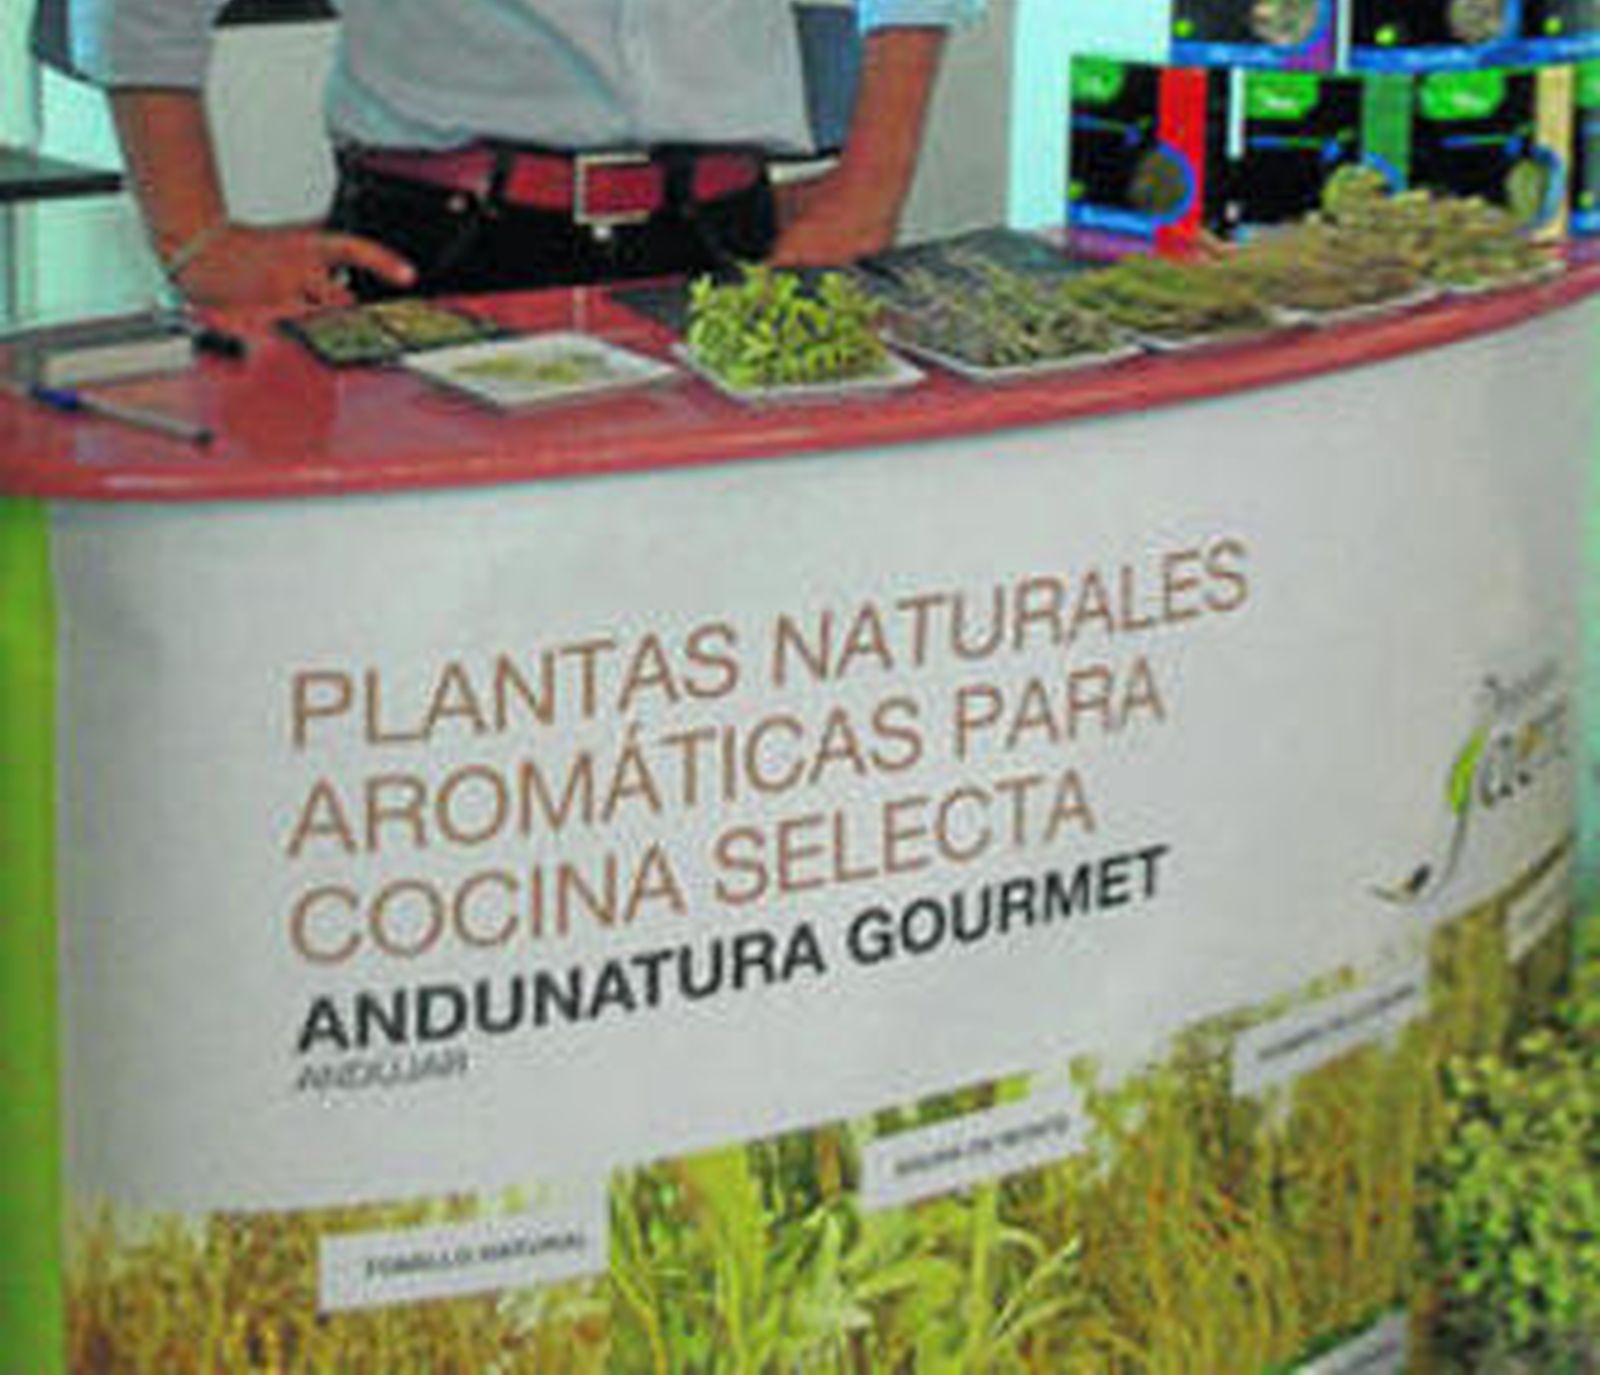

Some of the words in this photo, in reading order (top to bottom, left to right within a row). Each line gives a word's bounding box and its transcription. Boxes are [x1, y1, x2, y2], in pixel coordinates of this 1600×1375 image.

[292, 622, 739, 750] PLANTAS
[772, 539, 1248, 687] NATURALES
[286, 697, 922, 858] AROMÁTICAS
[954, 656, 1166, 761] PARA
[290, 842, 684, 964] COCINA
[715, 769, 1095, 905] SELECTA
[295, 922, 828, 1055] ANDUNATURA
[846, 843, 1171, 966] GOURMET
